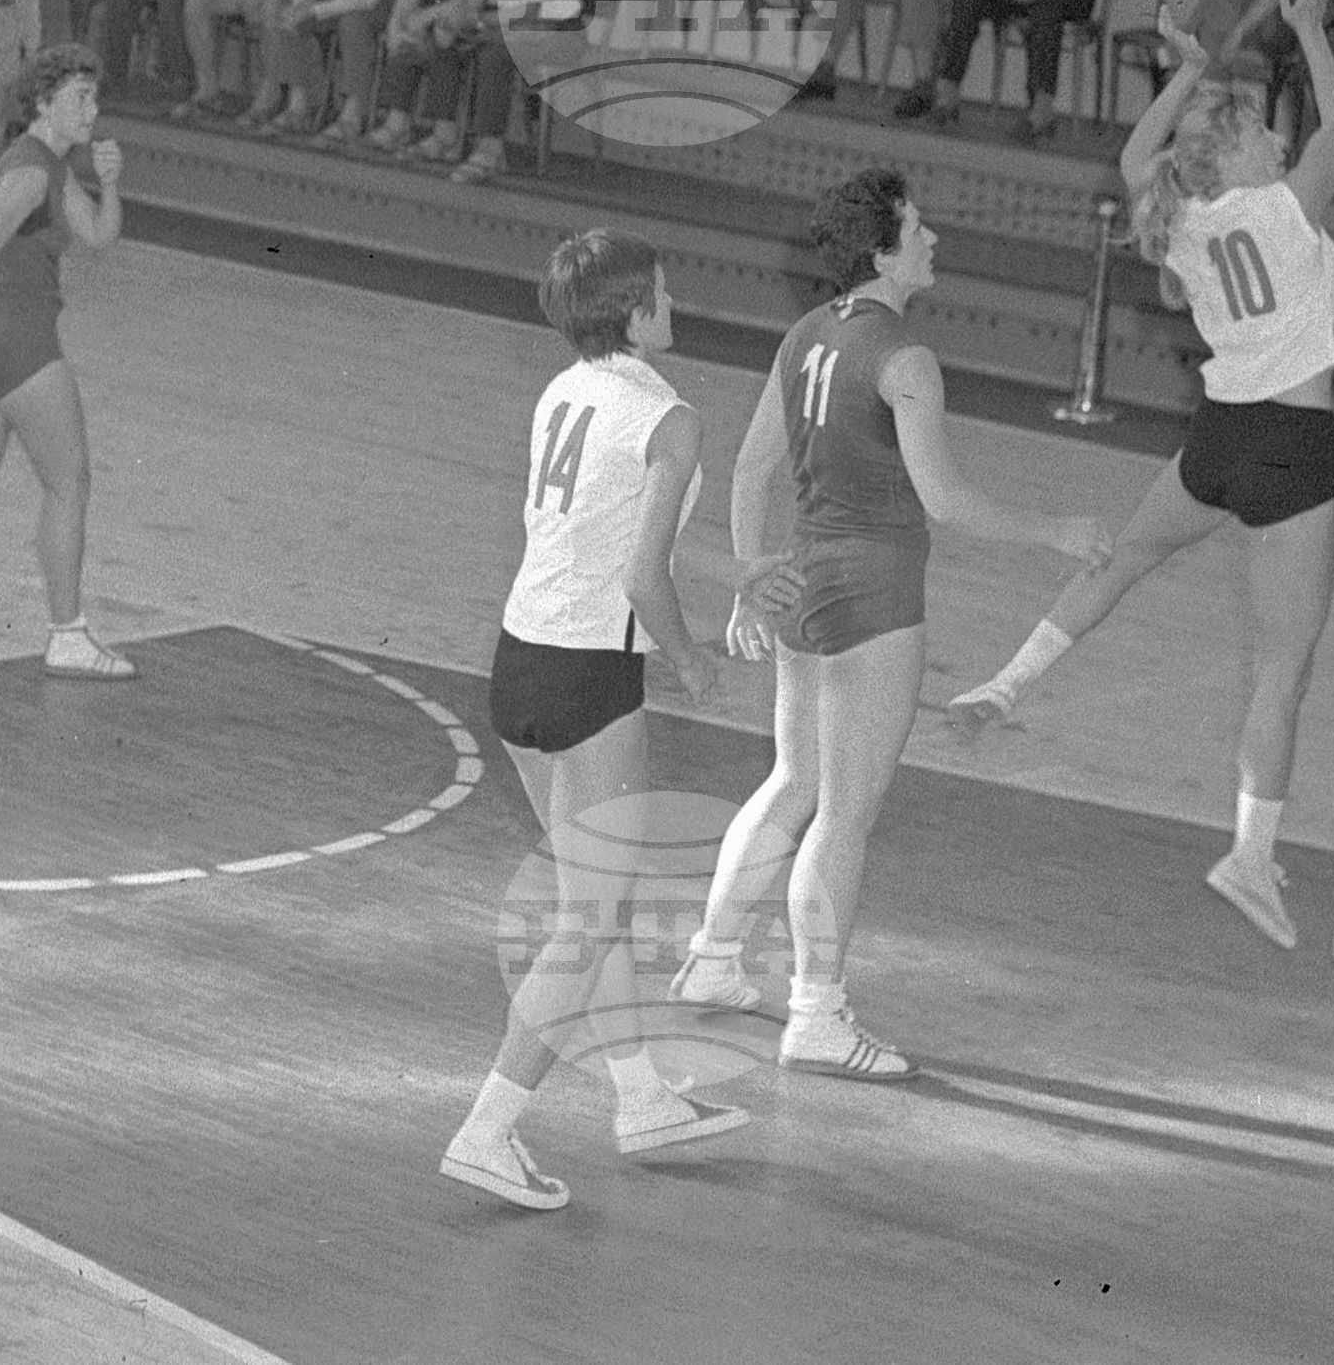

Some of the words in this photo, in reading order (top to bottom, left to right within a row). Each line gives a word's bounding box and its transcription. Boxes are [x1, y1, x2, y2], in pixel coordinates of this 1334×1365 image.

[1208, 229, 1277, 322] 10
[800, 343, 839, 426] 11
[534, 400, 596, 515] 14
